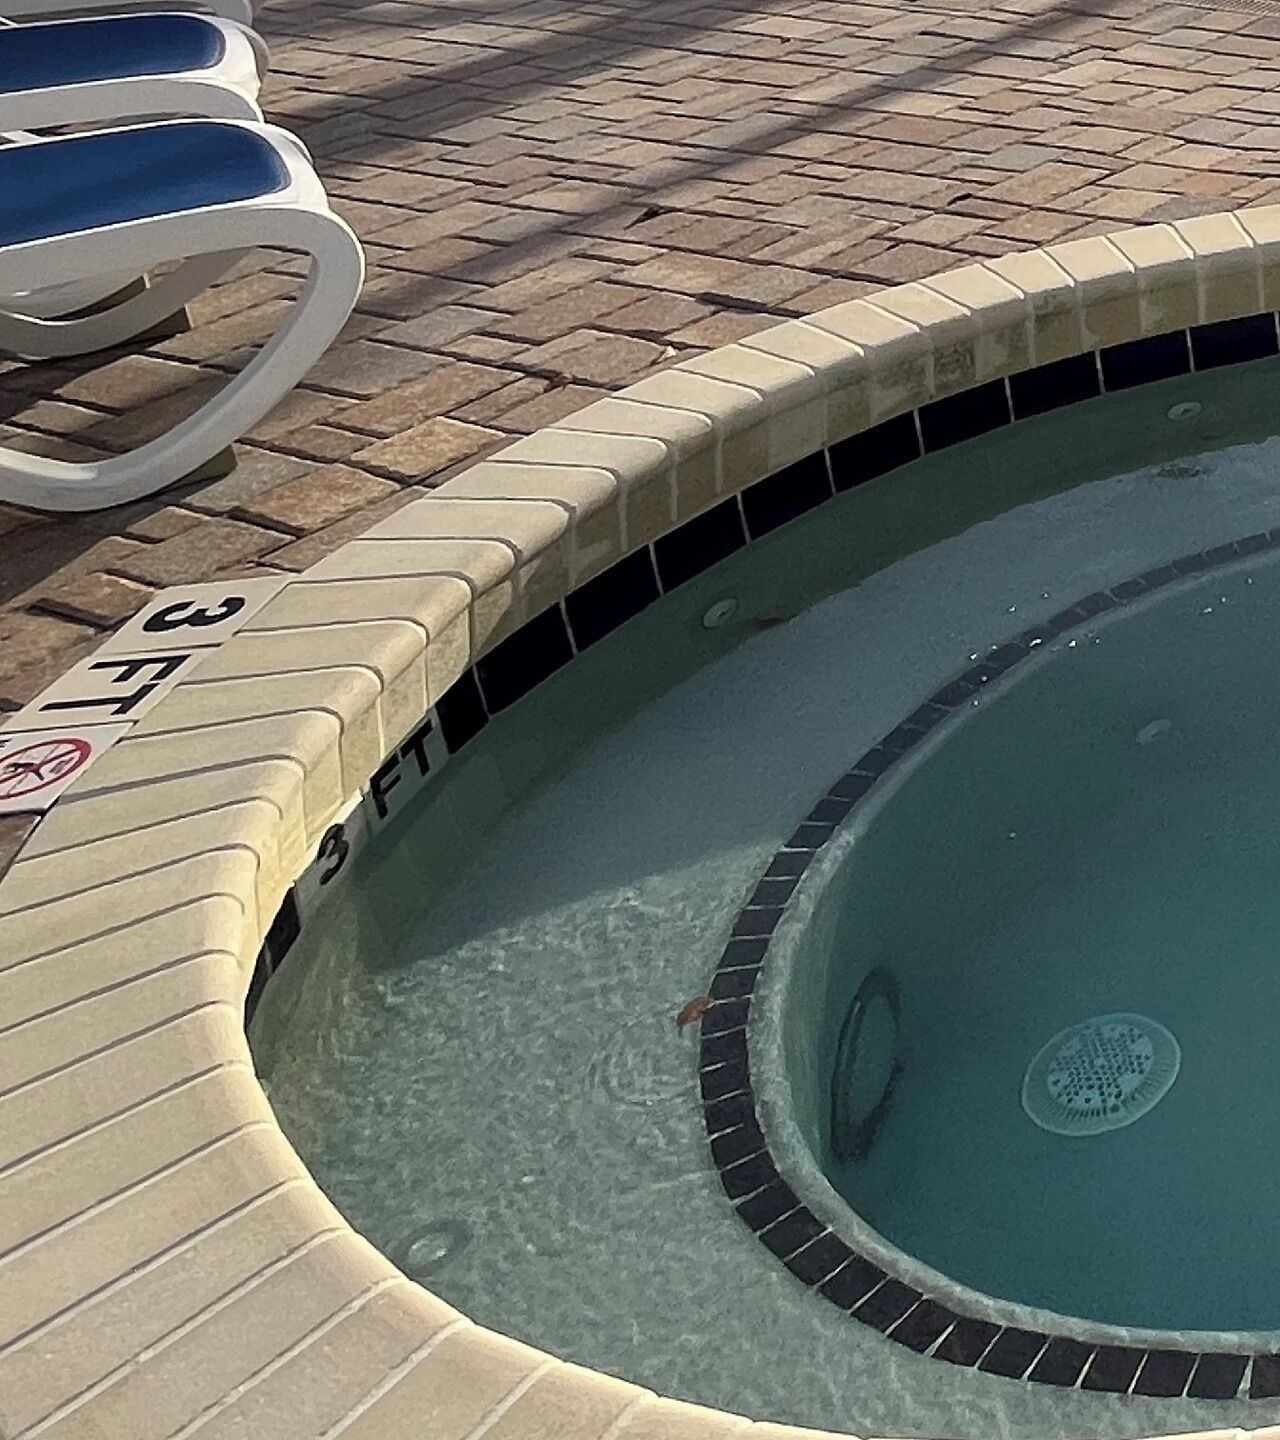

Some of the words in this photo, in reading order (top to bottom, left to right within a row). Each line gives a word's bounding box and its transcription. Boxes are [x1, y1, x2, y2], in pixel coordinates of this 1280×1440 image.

[143, 596, 246, 633] 3
[38, 654, 192, 716] FT
[316, 823, 349, 886] 3
[370, 718, 433, 820] FT
